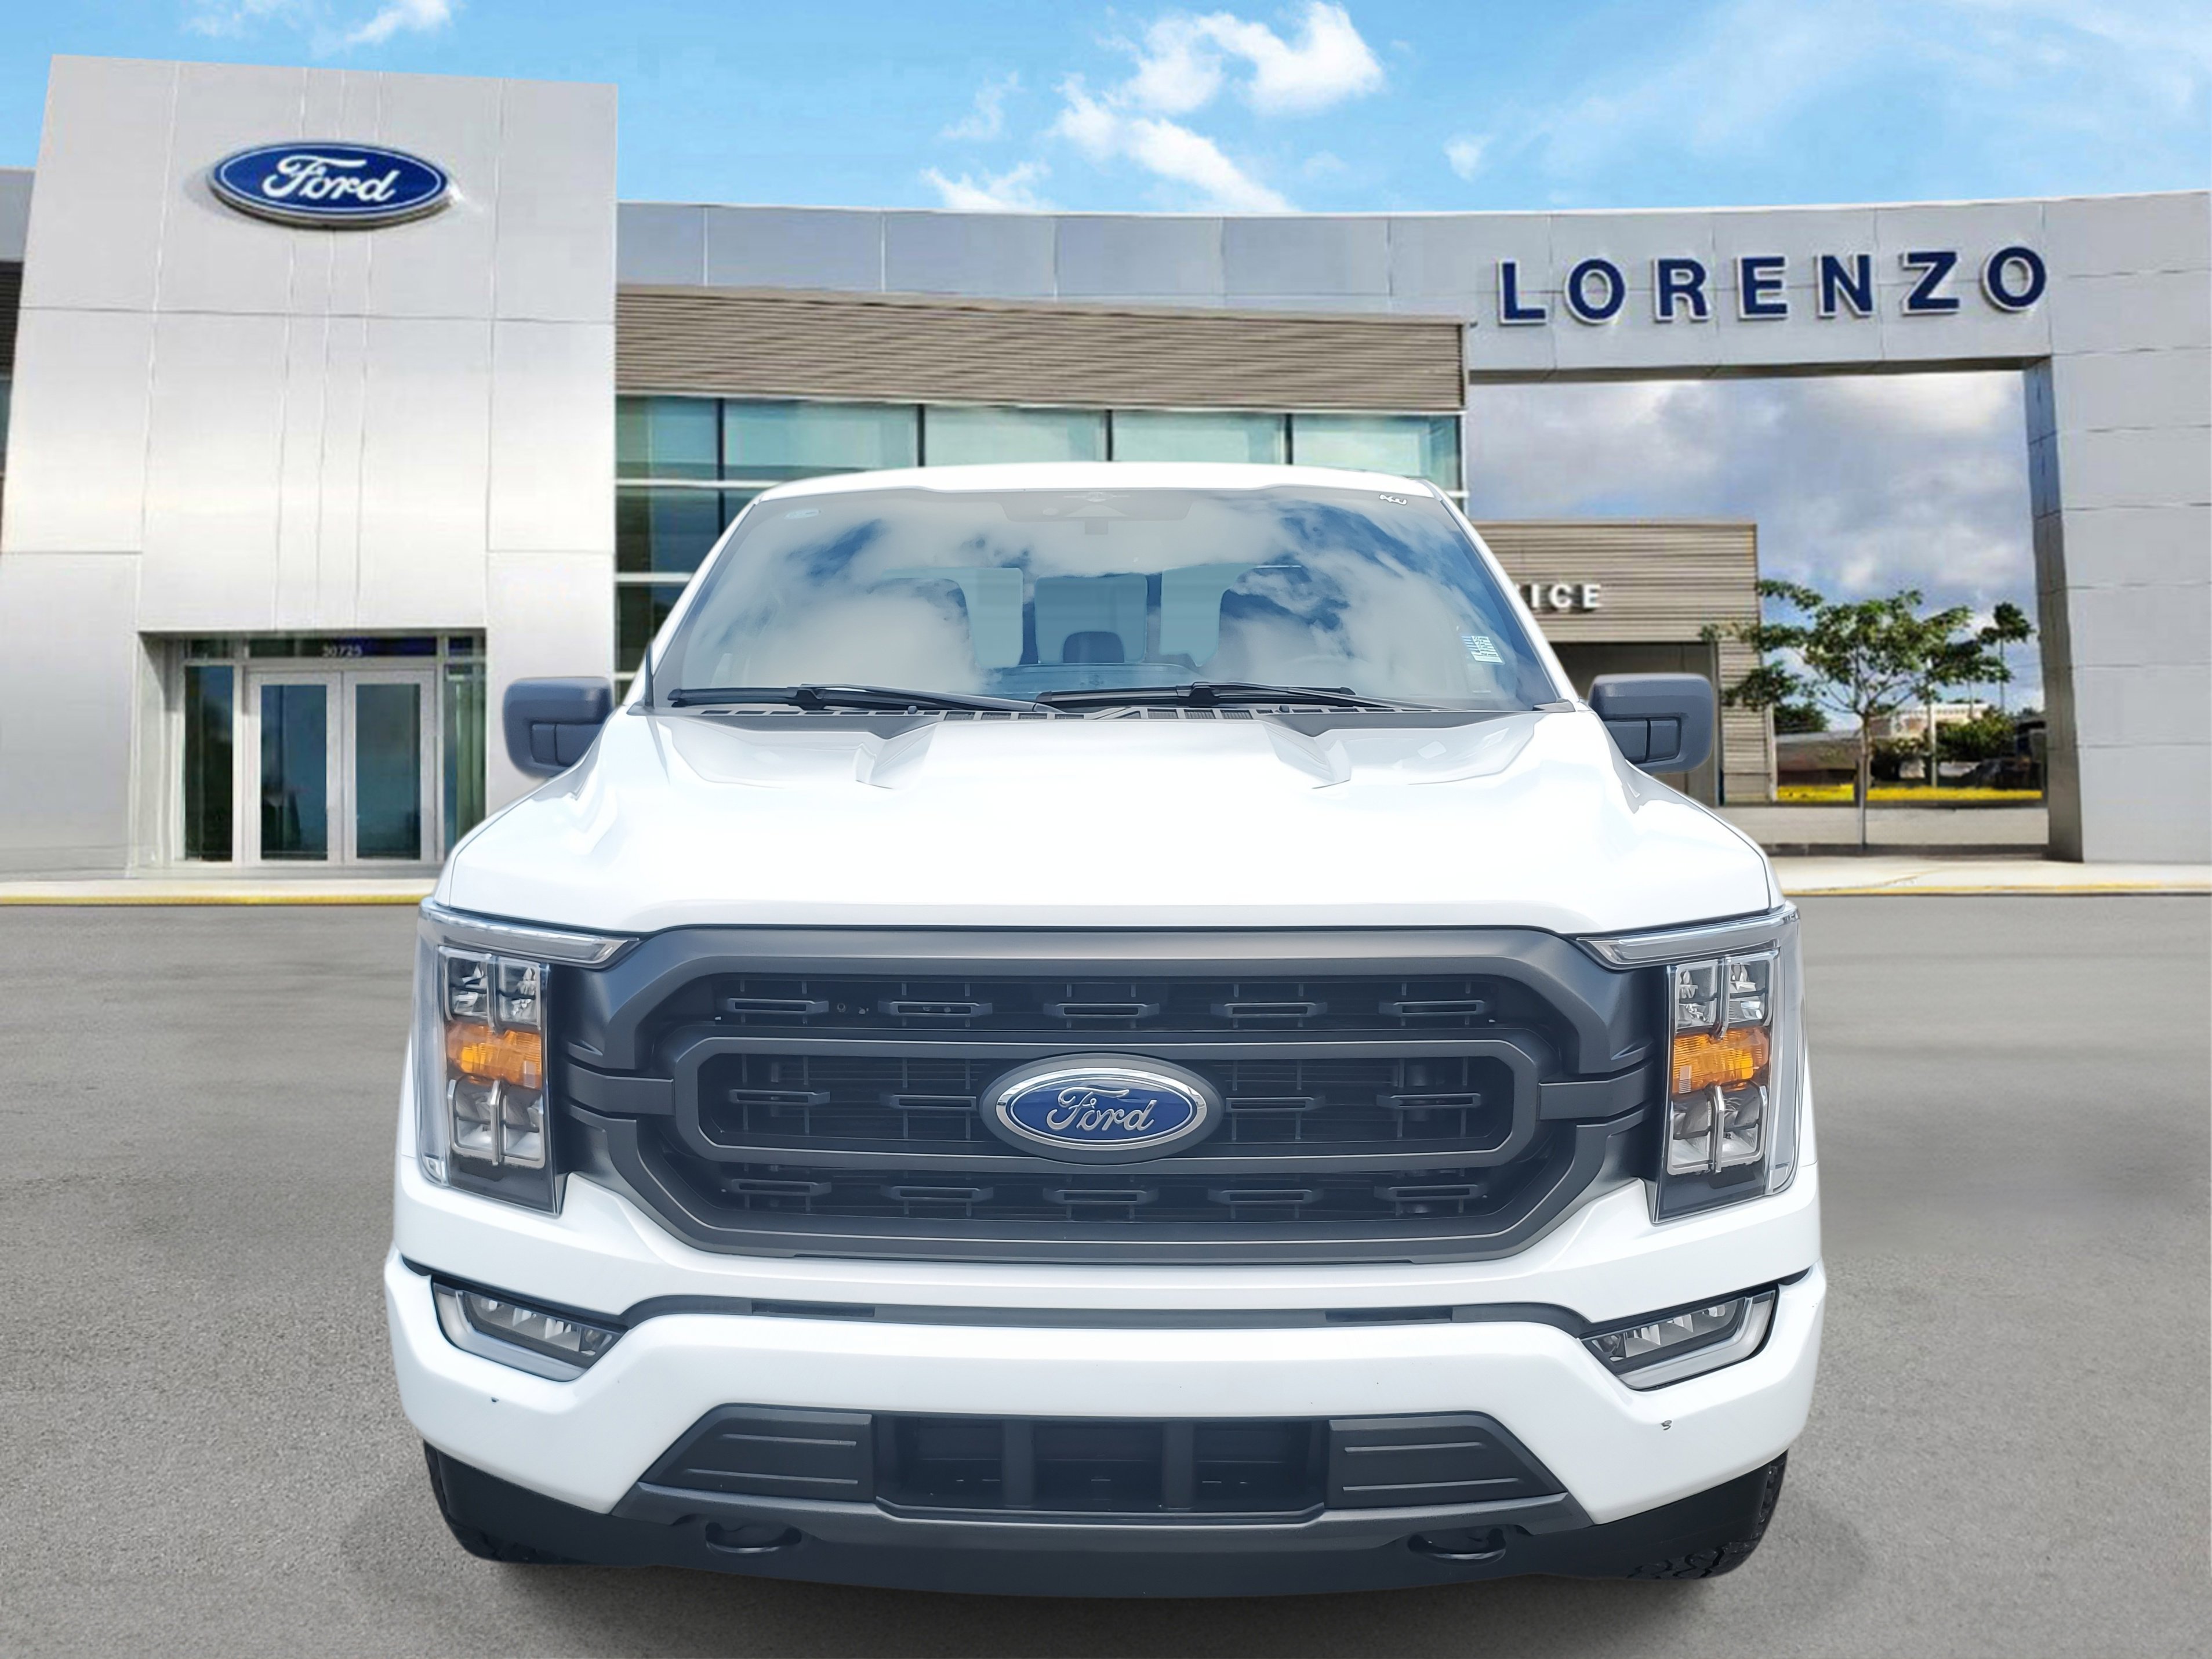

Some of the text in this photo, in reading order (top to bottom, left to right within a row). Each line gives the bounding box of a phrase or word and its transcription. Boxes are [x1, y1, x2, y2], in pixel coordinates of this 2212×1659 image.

[261, 154, 401, 202] Ford
[1498, 245, 2047, 326] LORENZO
[1515, 583, 1603, 608] ICE
[1046, 1086, 1157, 1131] Ford
